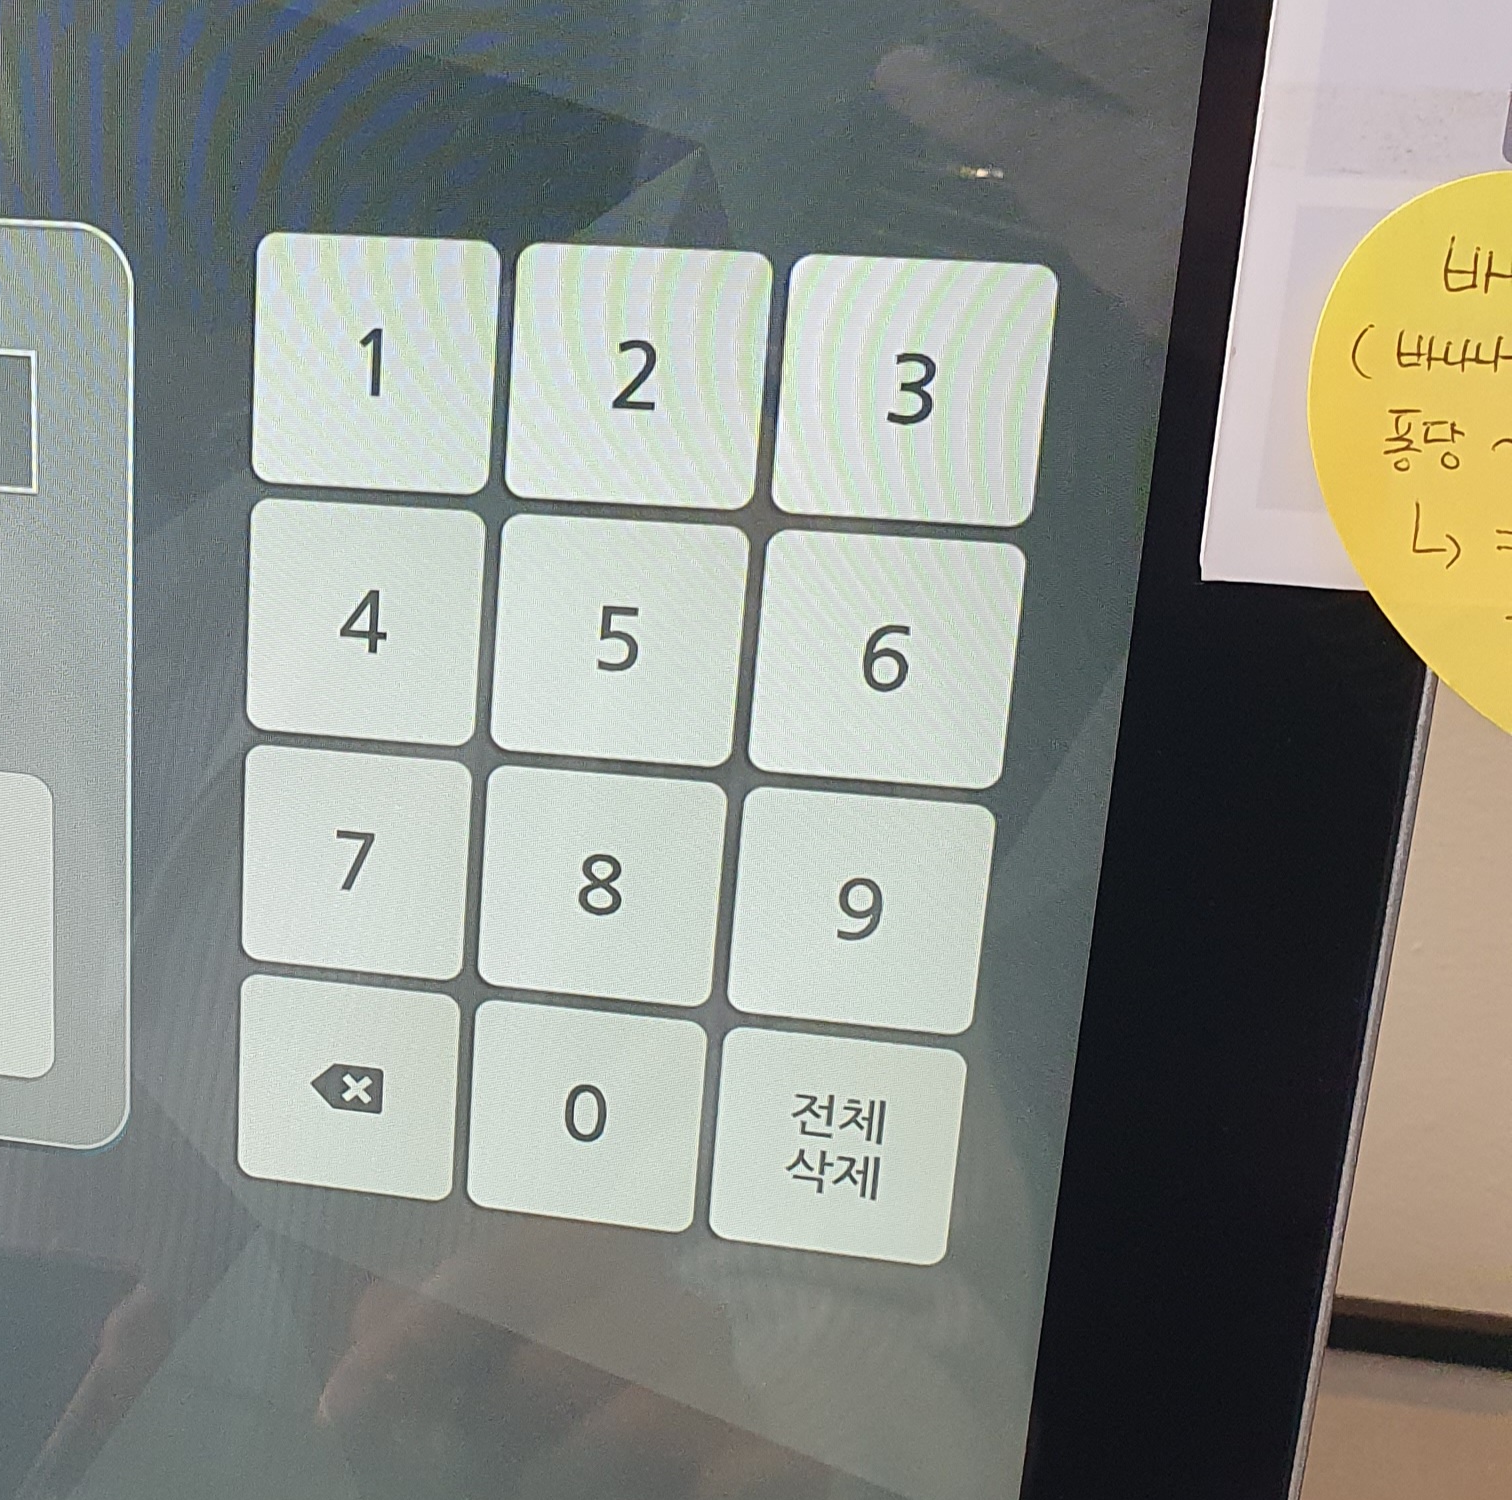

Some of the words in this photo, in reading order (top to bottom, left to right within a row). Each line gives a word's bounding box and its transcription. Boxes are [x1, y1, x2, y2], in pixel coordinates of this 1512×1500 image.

[358, 327, 384, 399] 1
[611, 339, 659, 412] 2
[887, 352, 938, 426] 3
[339, 588, 388, 654] 4
[596, 605, 641, 671] 5
[863, 623, 911, 692] 6
[334, 828, 376, 891] 7
[577, 853, 624, 917] 8
[837, 876, 884, 942] 9
[565, 1082, 608, 1143] 0
[790, 1090, 888, 1146] 전체
[785, 1148, 882, 1203] 삭제
